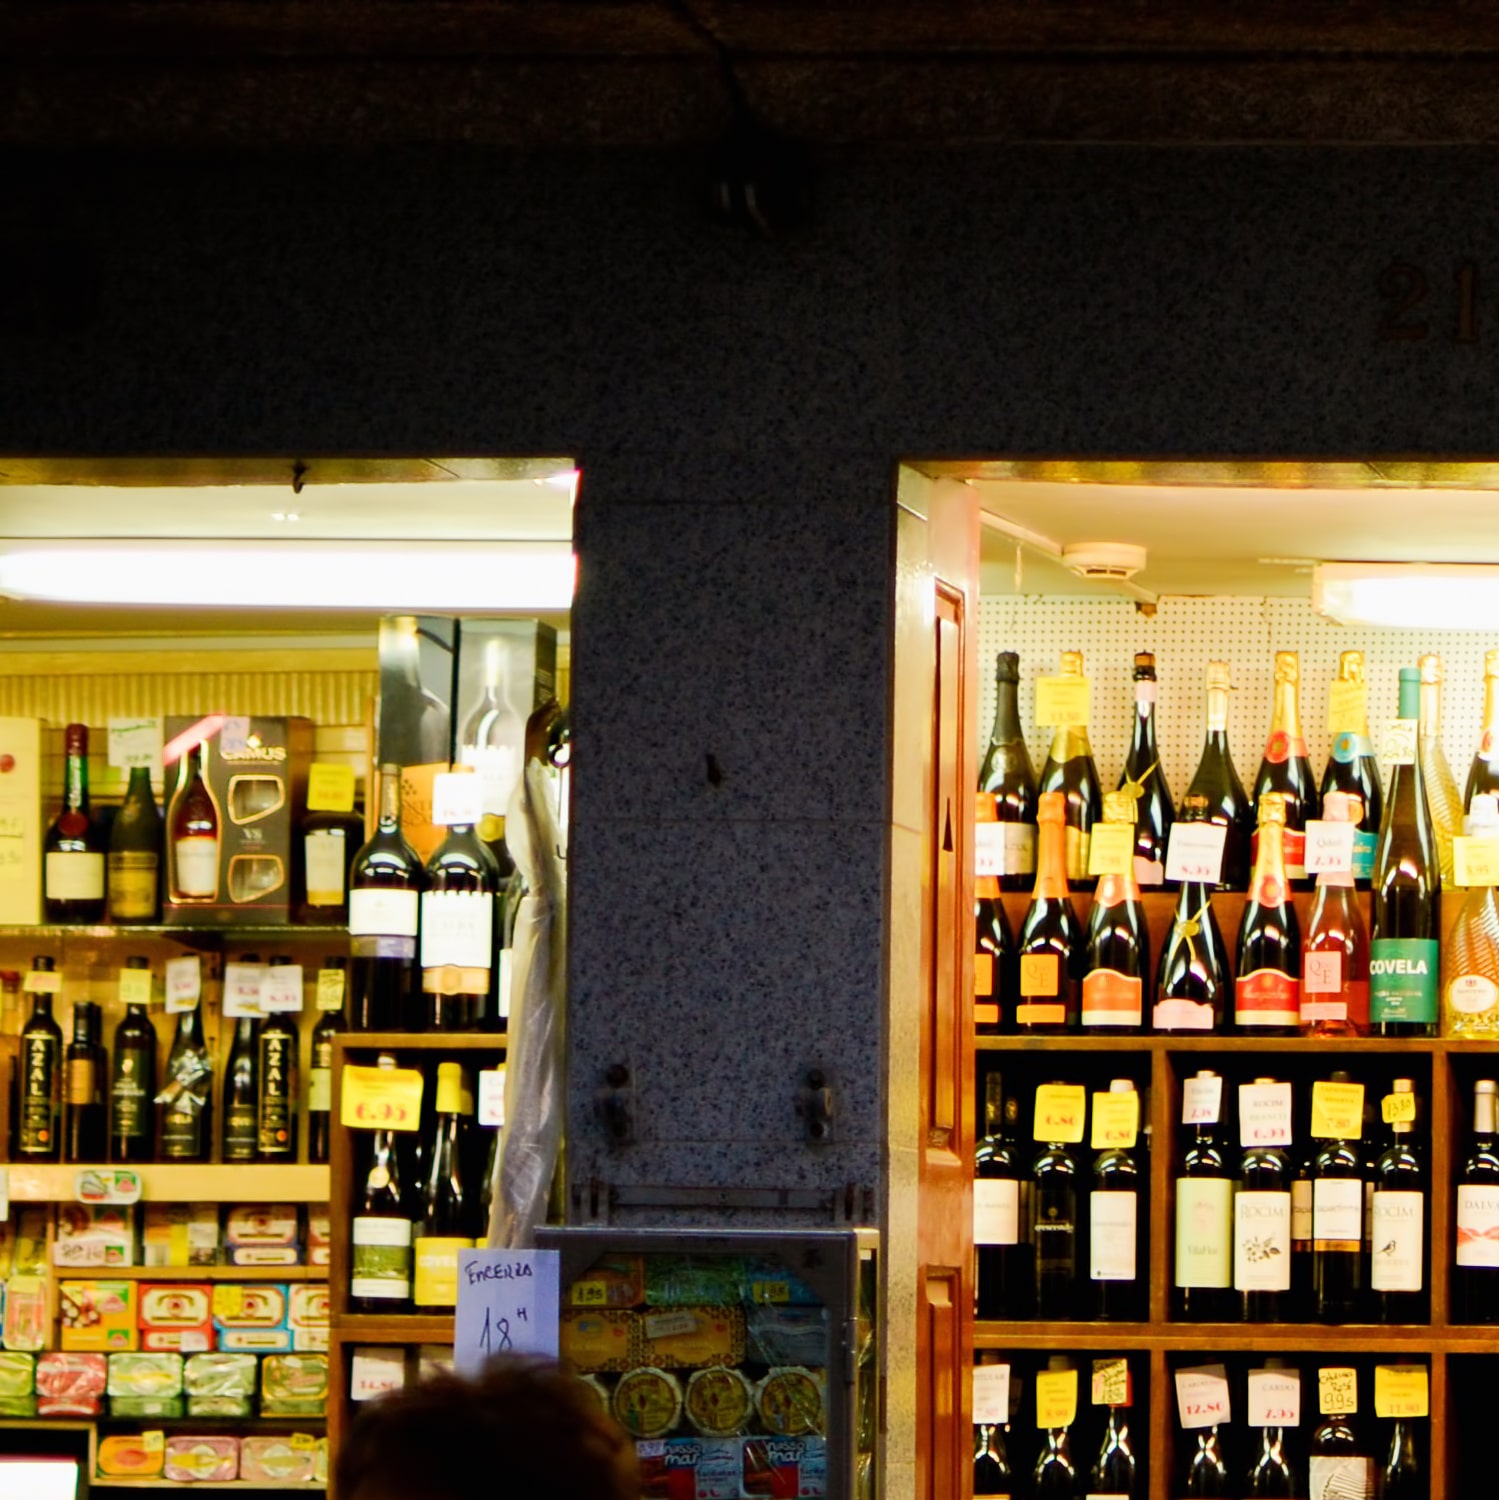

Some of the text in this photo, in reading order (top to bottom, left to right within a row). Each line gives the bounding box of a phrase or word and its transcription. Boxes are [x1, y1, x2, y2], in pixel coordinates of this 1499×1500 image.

[220, 745, 287, 763] CAMUS
[1369, 959, 1428, 976] COVELA
[26, 1037, 45, 1098] AZAL
[267, 1037, 283, 1098] AZAL
[355, 1103, 408, 1123] 6.95
[1239, 1205, 1284, 1219] ROCIM
